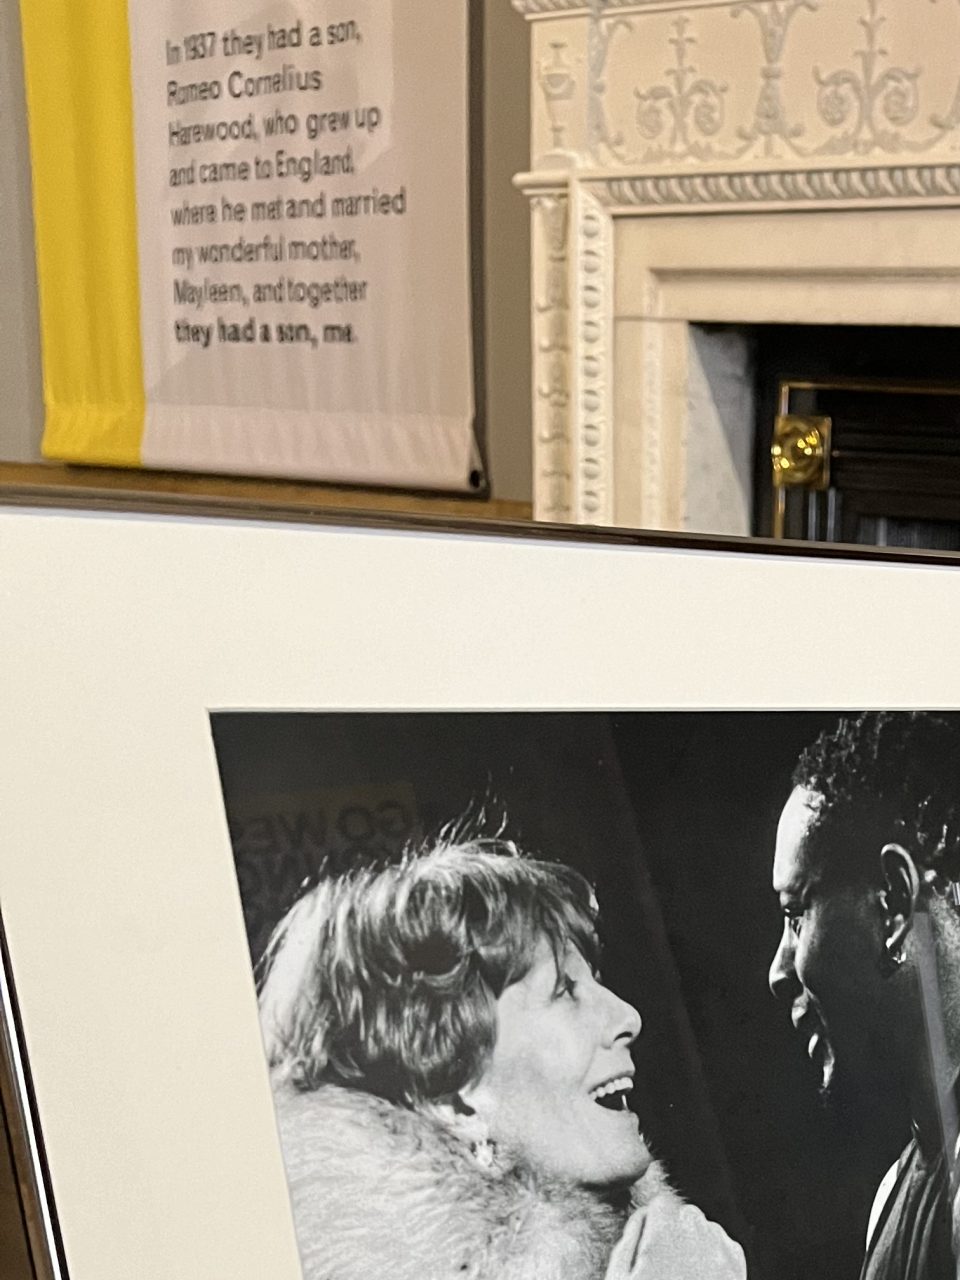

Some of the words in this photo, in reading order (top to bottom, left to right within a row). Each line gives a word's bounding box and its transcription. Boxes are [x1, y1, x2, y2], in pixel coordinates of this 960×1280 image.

[166, 39, 182, 66] In
[183, 31, 216, 61] 1937
[222, 29, 264, 60] they
[267, 19, 302, 51] had
[309, 25, 321, 47] a
[326, 20, 362, 45] son,
[167, 79, 221, 107] Romeo
[228, 63, 322, 99] Cornelius
[263, 109, 297, 137] who
[306, 110, 350, 140] grew
[354, 105, 381, 133] up
[169, 158, 195, 187] and
[199, 160, 249, 184] came
[255, 154, 271, 180] to
[171, 200, 217, 226] where
[222, 197, 246, 223] he
[251, 195, 282, 222] met
[286, 192, 326, 218] and
[331, 186, 407, 217] married
[172, 246, 192, 270] my
[197, 234, 283, 264] wonderful
[253, 276, 283, 304] and
[287, 275, 367, 308] together
[174, 318, 211, 349] they
[217, 317, 256, 343] had
[260, 324, 271, 342] a
